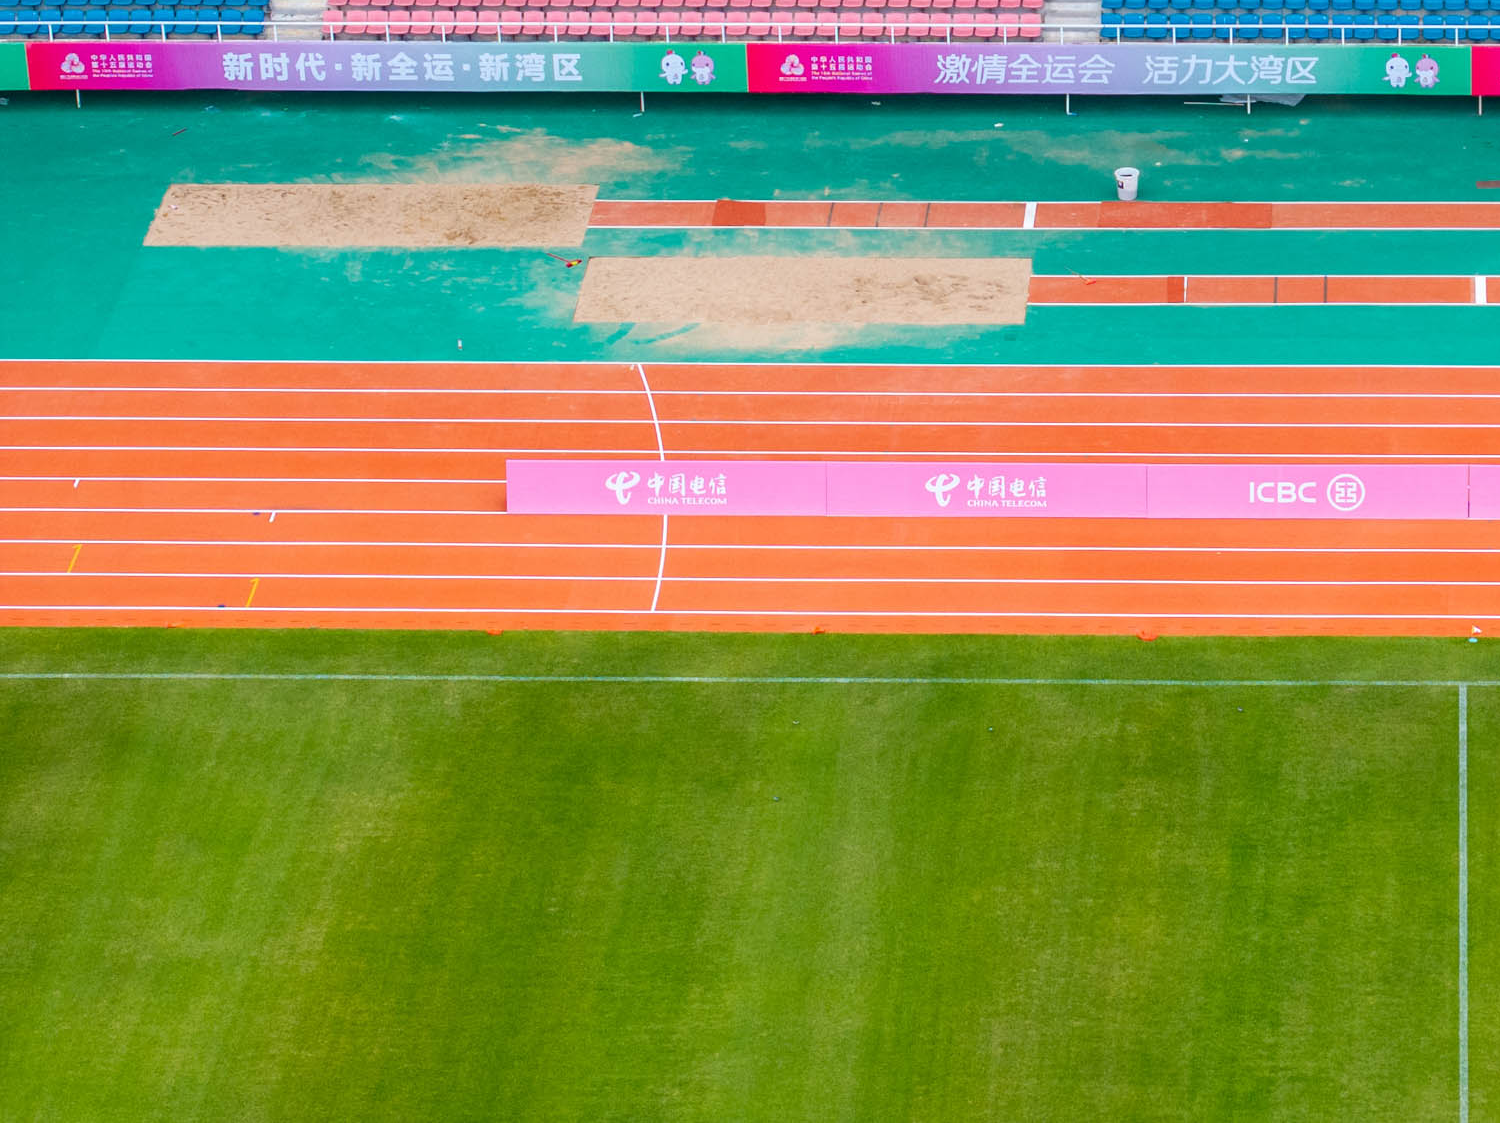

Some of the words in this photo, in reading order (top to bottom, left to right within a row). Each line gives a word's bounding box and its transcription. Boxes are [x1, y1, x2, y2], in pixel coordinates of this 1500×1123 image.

[934, 53, 1114, 85] 激情全运会
[1142, 53, 1320, 85] 活力大湾区
[647, 472, 727, 496] 中国电信
[967, 475, 1047, 498] 中国电信
[1249, 481, 1317, 504] ICBC
[648, 497, 679, 505] CHINA
[682, 497, 728, 505] TELECOM
[967, 499, 999, 507] CHINA
[1001, 499, 1047, 508] TELECOM
